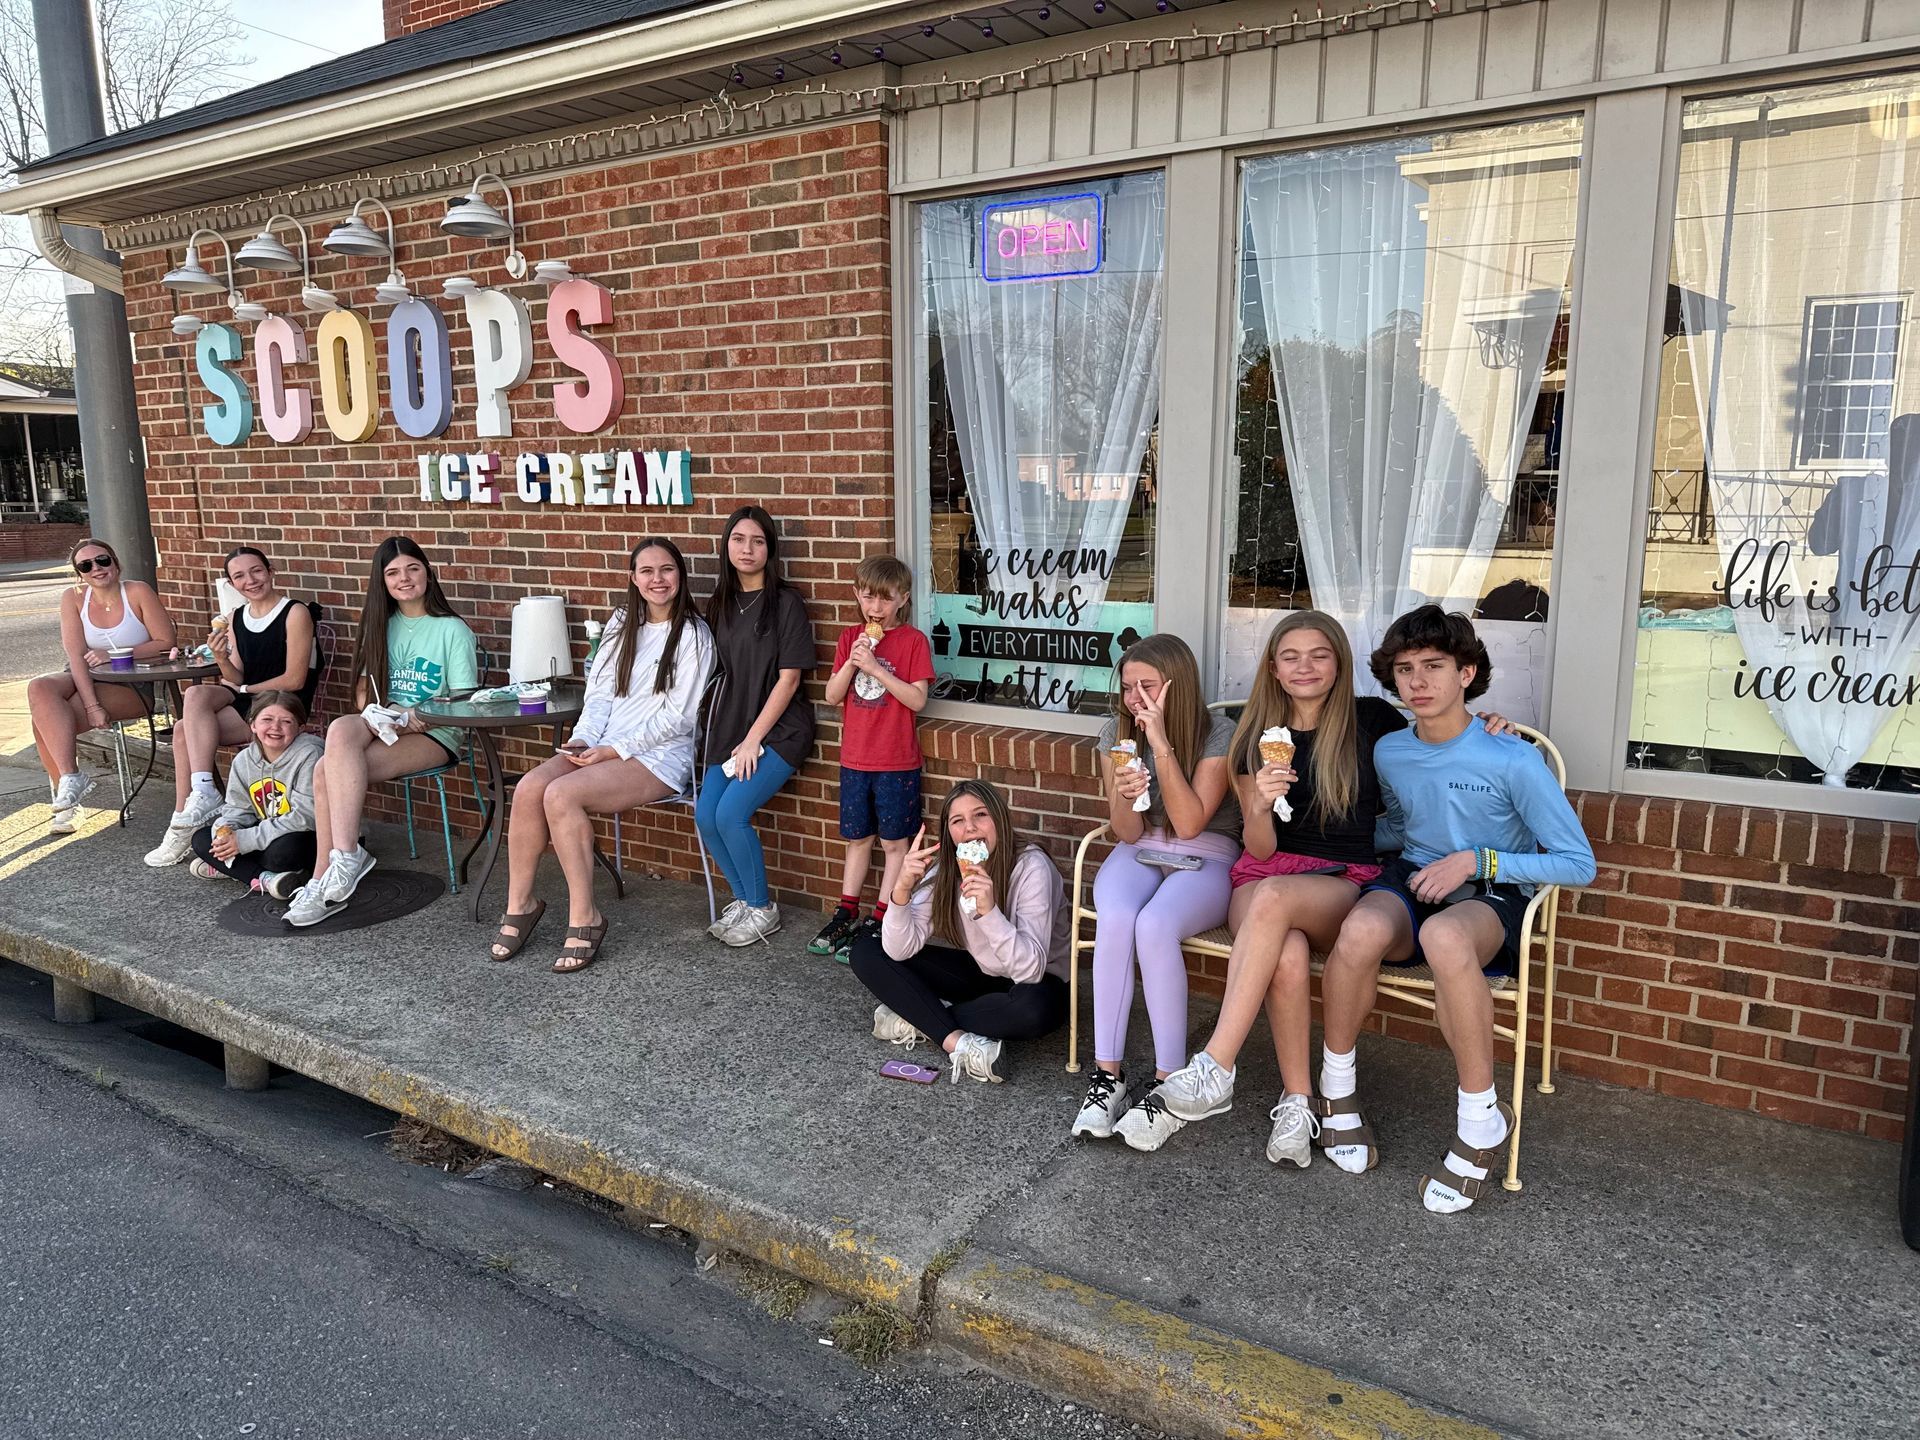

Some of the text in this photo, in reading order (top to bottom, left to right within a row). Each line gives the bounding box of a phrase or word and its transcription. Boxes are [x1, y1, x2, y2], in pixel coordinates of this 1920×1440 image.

[997, 218, 1087, 257] OPEN
[196, 278, 625, 446] SCOOPS
[418, 451, 692, 507] ICE CREAM
[1007, 547, 1117, 581] cream
[1712, 538, 1796, 623] life
[1805, 580, 1841, 613] is
[981, 581, 1088, 627] makes
[970, 629, 1099, 662] EVERYTHING
[391, 680, 417, 691] PEACE
[979, 662, 1087, 710] better
[1733, 659, 1797, 702] ice
[1448, 782, 1491, 792] SALT LIFE
